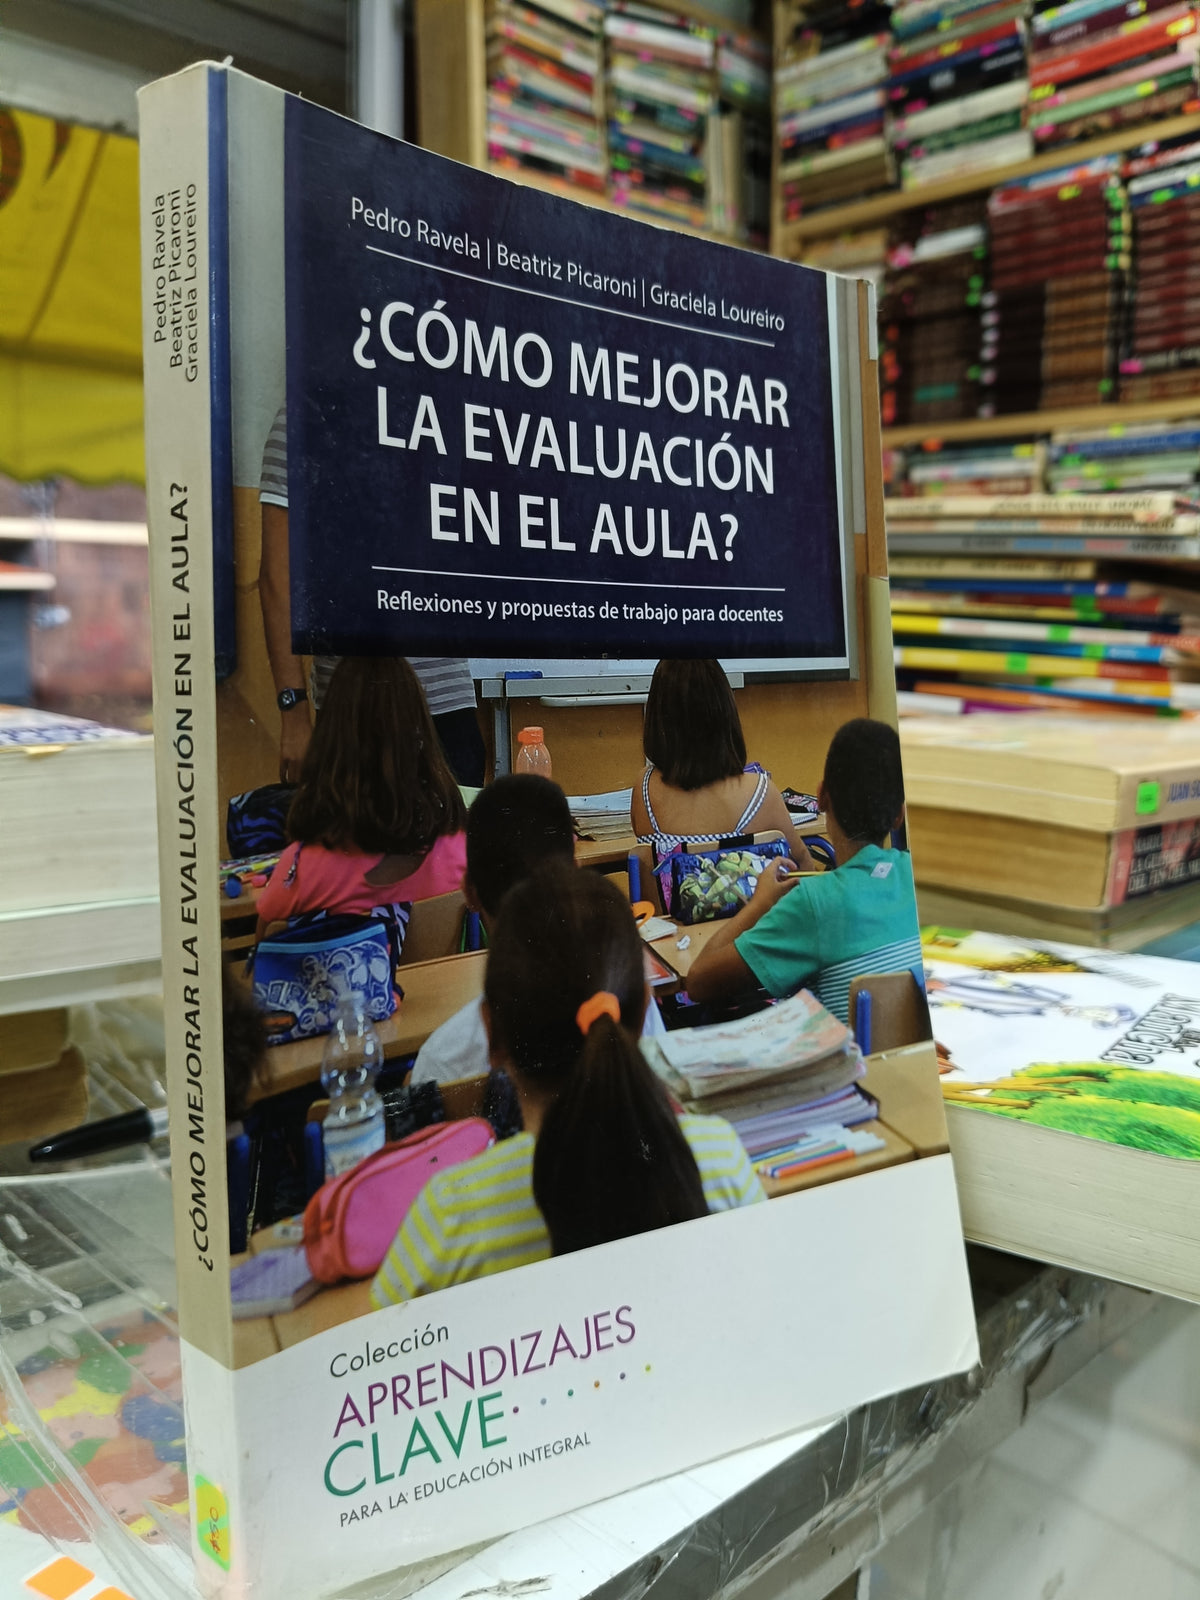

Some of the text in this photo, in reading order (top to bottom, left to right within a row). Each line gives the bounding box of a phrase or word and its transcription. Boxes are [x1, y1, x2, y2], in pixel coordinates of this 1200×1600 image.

[152, 194, 167, 343] Pedro Ravela
[168, 189, 183, 368] Beatriz Picaroni
[183, 183, 199, 382] Graciela Loureiro
[350, 196, 412, 238] Pedro
[416, 218, 481, 260] Ravela
[497, 243, 562, 281] Beatriz
[567, 262, 636, 299] Picaroni
[650, 283, 717, 318] Graciela
[721, 299, 785, 332] Loureiro
[352, 299, 790, 428] ¿CÓMO MEJORAR
[377, 385, 775, 495] LA EVALUACIÓN
[429, 482, 739, 562] EN EL AULA?
[376, 588, 784, 624] Reflexiones y propuestas de trabajo para docentes
[169, 482, 214, 1273] ¿CÓMO MEJORAR LA EVALUACIÓN EN EL AULA?
[329, 1323, 449, 1378] Colección
[333, 1305, 636, 1438] APRENDIZAJES
[324, 1391, 507, 1497] CLAVE
[340, 1431, 591, 1527] PARA LA EDUCACIÓN INTEGRAL
